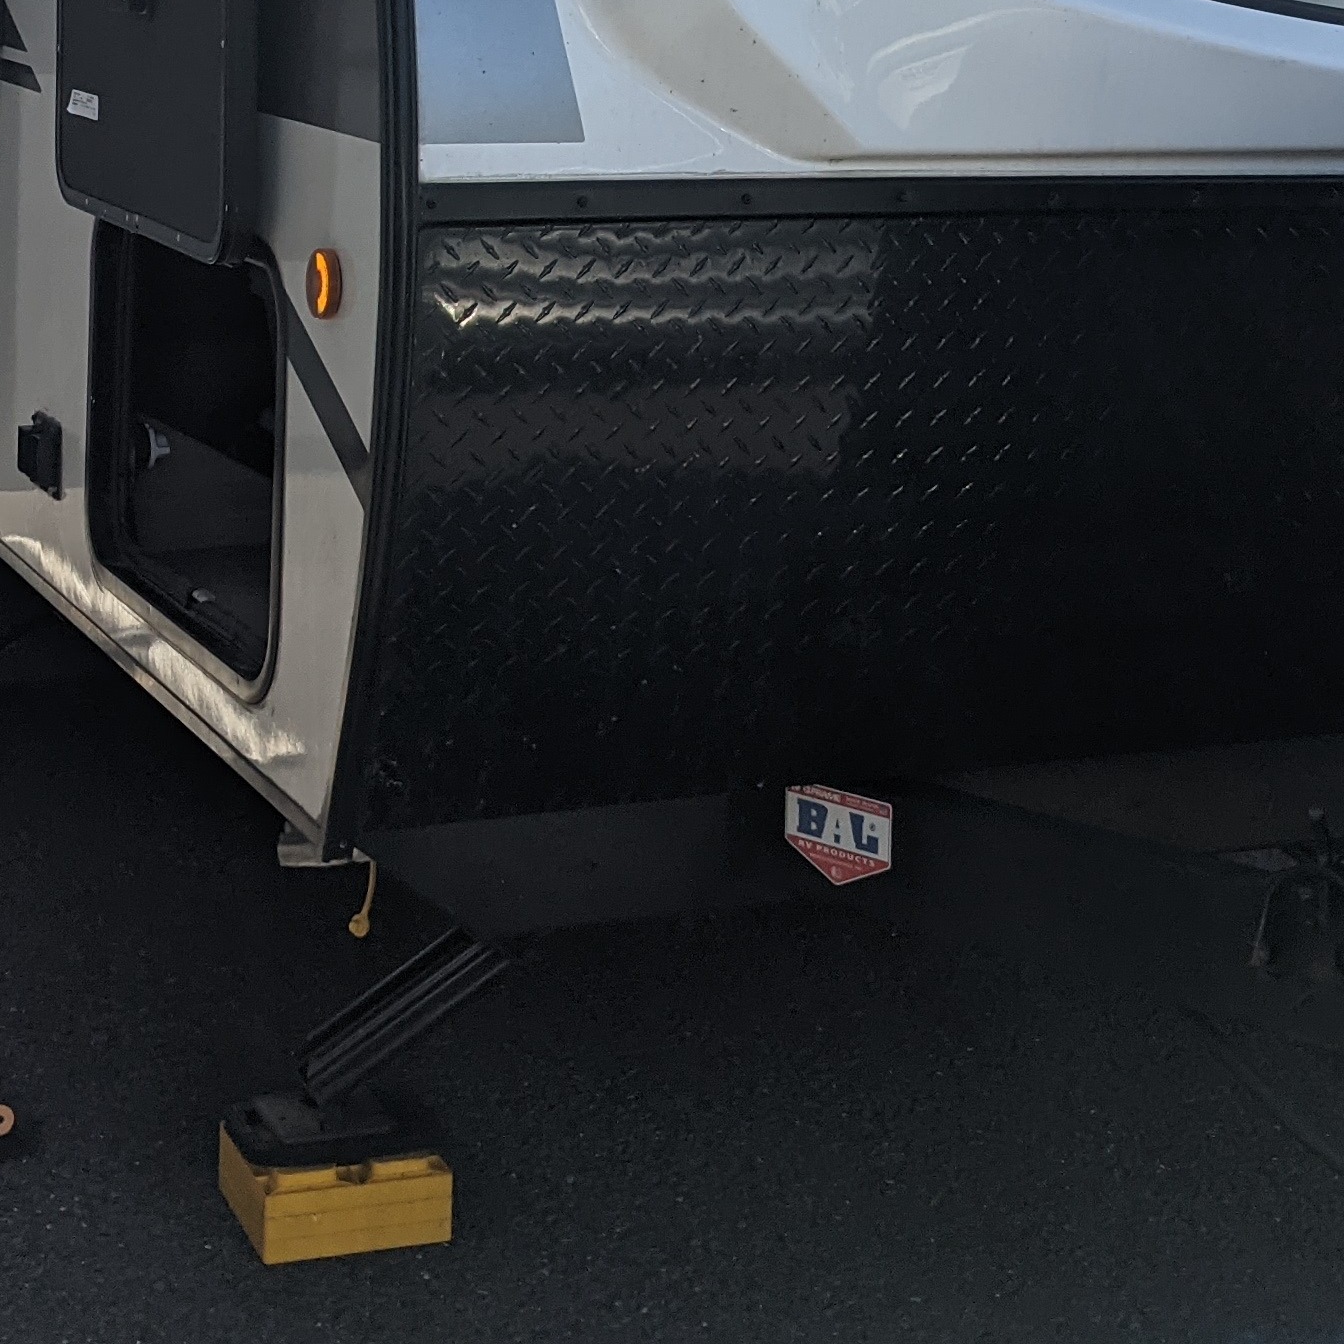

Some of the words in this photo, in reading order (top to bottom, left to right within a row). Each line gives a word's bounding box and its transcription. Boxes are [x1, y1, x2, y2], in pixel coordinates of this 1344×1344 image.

[796, 798, 879, 856] BAL
[798, 839, 813, 850] RV
[816, 843, 876, 868] PRODUCTS
